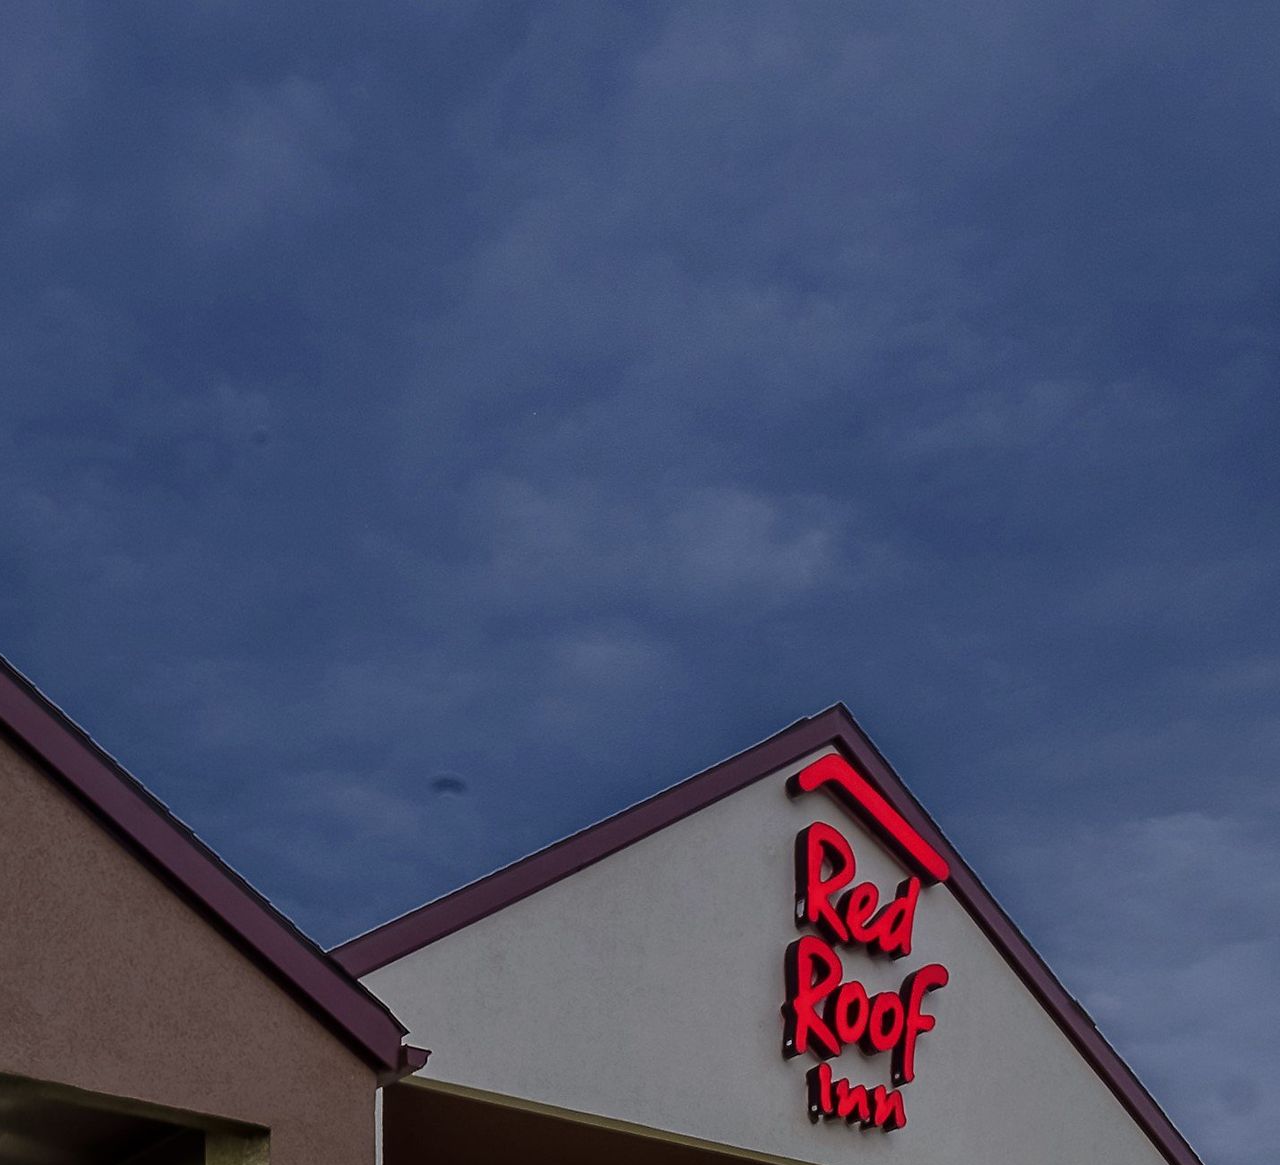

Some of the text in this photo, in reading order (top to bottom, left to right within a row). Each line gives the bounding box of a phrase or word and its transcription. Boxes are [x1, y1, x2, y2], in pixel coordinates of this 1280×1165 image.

[797, 821, 920, 958] Red
[785, 934, 949, 1084] Roof
[812, 1062, 907, 1130] Inn
